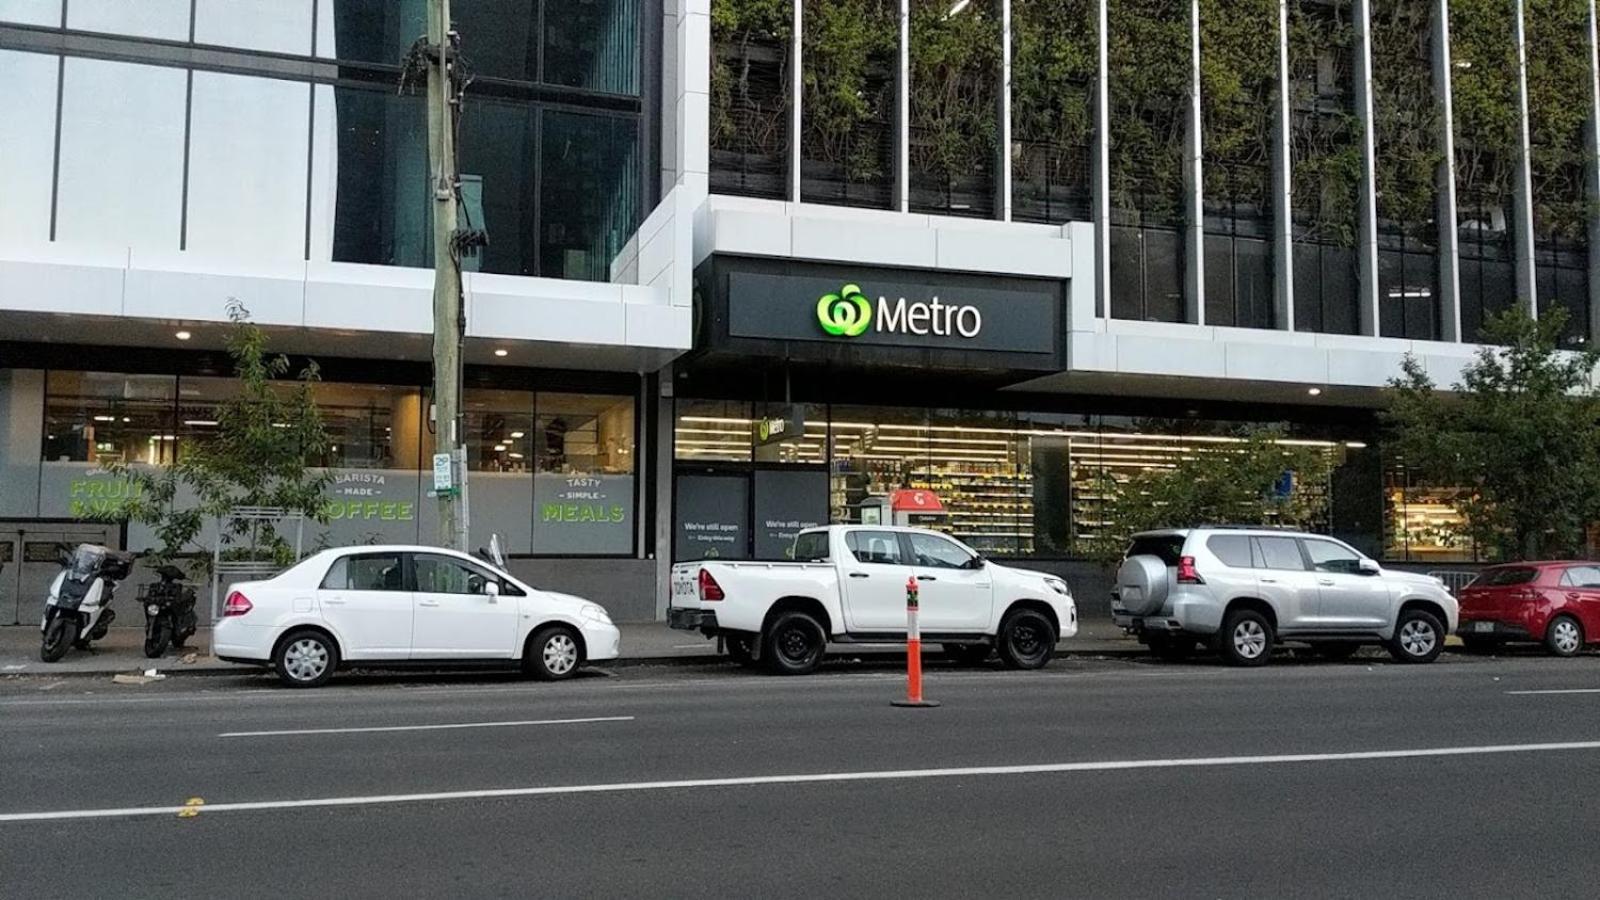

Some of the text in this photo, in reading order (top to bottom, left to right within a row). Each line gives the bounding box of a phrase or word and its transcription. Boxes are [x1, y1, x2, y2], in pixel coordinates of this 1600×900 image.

[876, 296, 982, 338] Metro
[566, 478, 601, 487] TASTY
[344, 487, 373, 496] MADE
[566, 491, 600, 500] SIMPLE
[322, 500, 414, 520] OFFEE
[543, 503, 625, 523] MEALS
